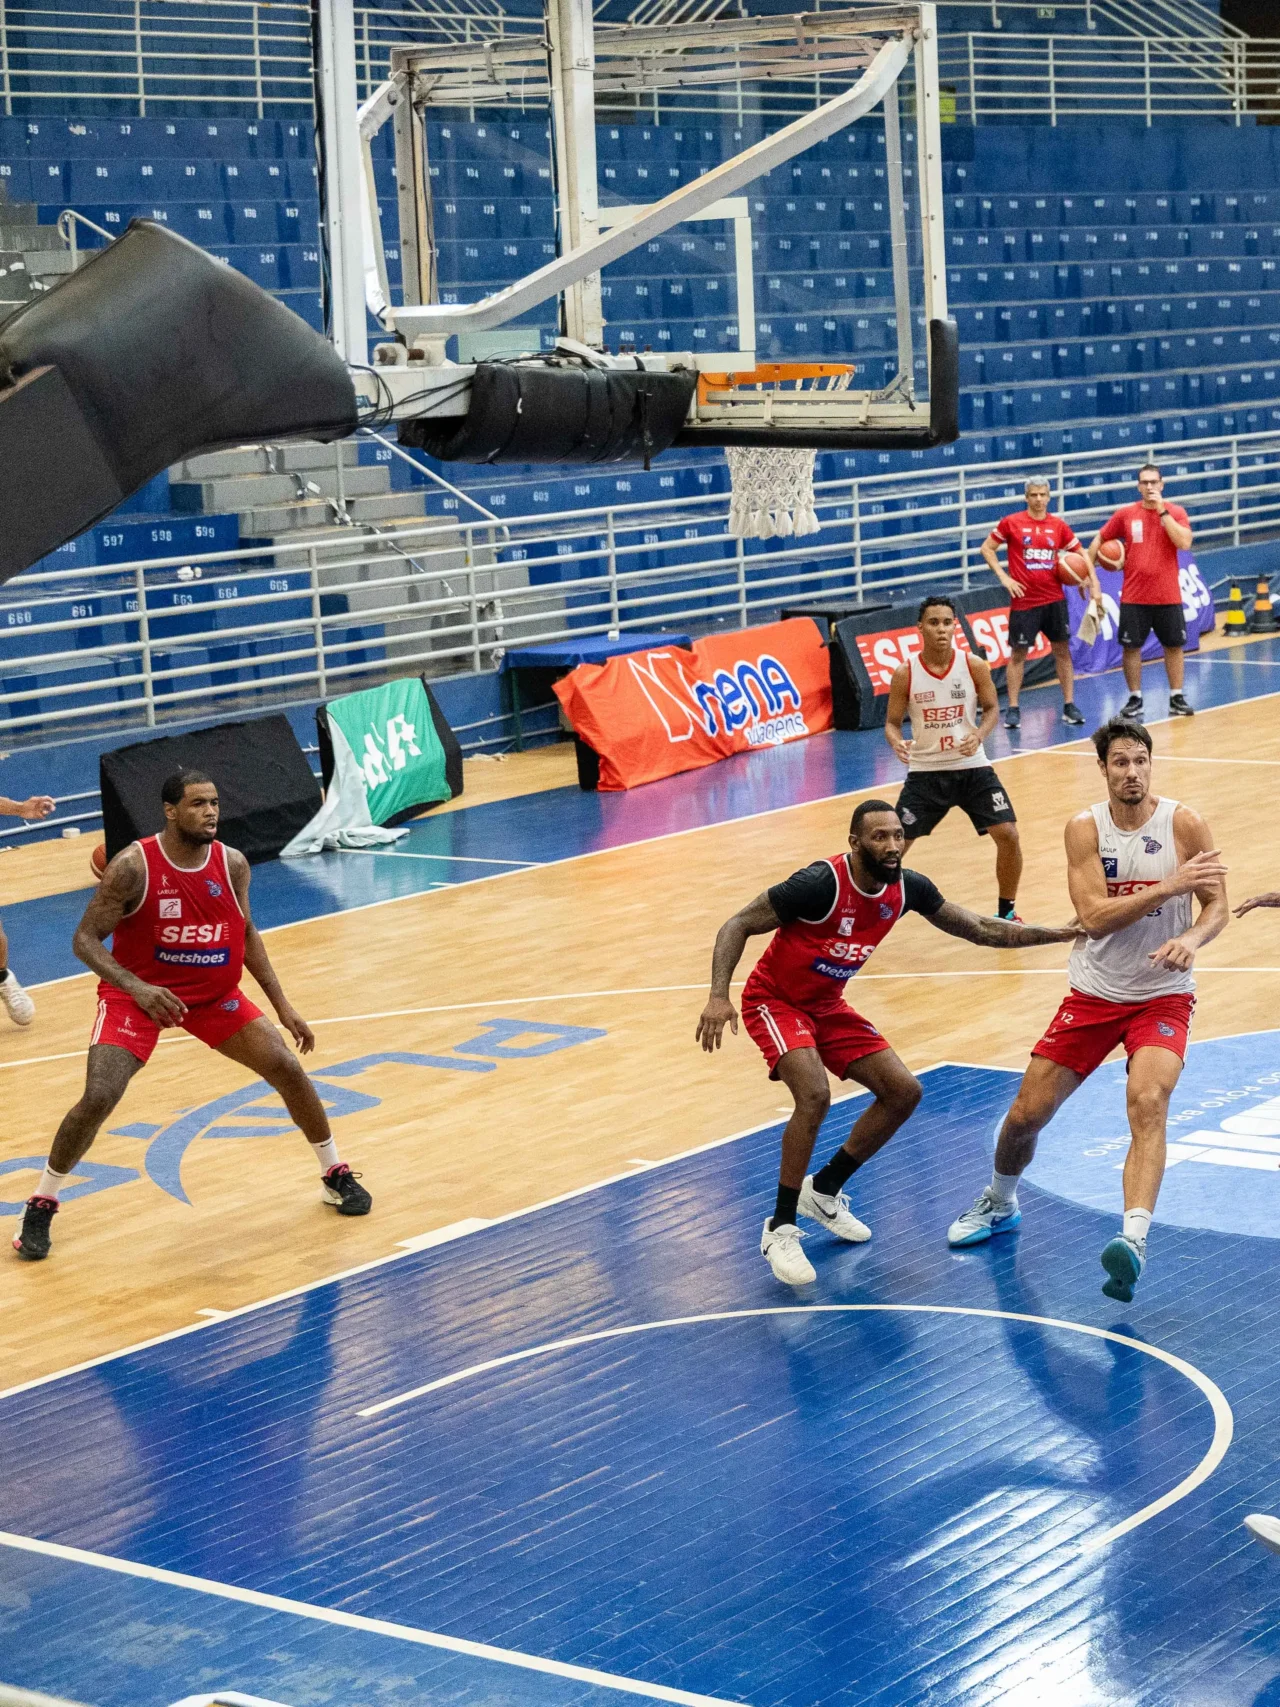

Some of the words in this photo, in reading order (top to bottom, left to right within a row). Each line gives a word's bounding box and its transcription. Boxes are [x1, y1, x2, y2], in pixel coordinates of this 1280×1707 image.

[376, 450, 392, 460] 533
[575, 485, 590, 495] 604
[490, 494, 506, 505] 602
[533, 491, 549, 501] 603
[443, 499, 458, 509] 601
[152, 530, 172, 541] 598
[195, 526, 214, 537] 599
[103, 534, 123, 546] 597
[1025, 548, 1053, 560] SESI
[270, 580, 289, 591] 665
[218, 587, 238, 599] 664
[173, 593, 193, 605] 663
[126, 600, 139, 611] 66
[72, 606, 92, 617] 661
[8, 612, 31, 624] 660
[926, 707, 960, 721] SESI
[924, 722, 940, 730] SÃO
[940, 736, 955, 751] 13
[161, 924, 223, 943] SESI
[829, 942, 876, 961] SES
[1061, 1012, 1074, 1024] 12
[1200, 1085, 1260, 1109] POVO
